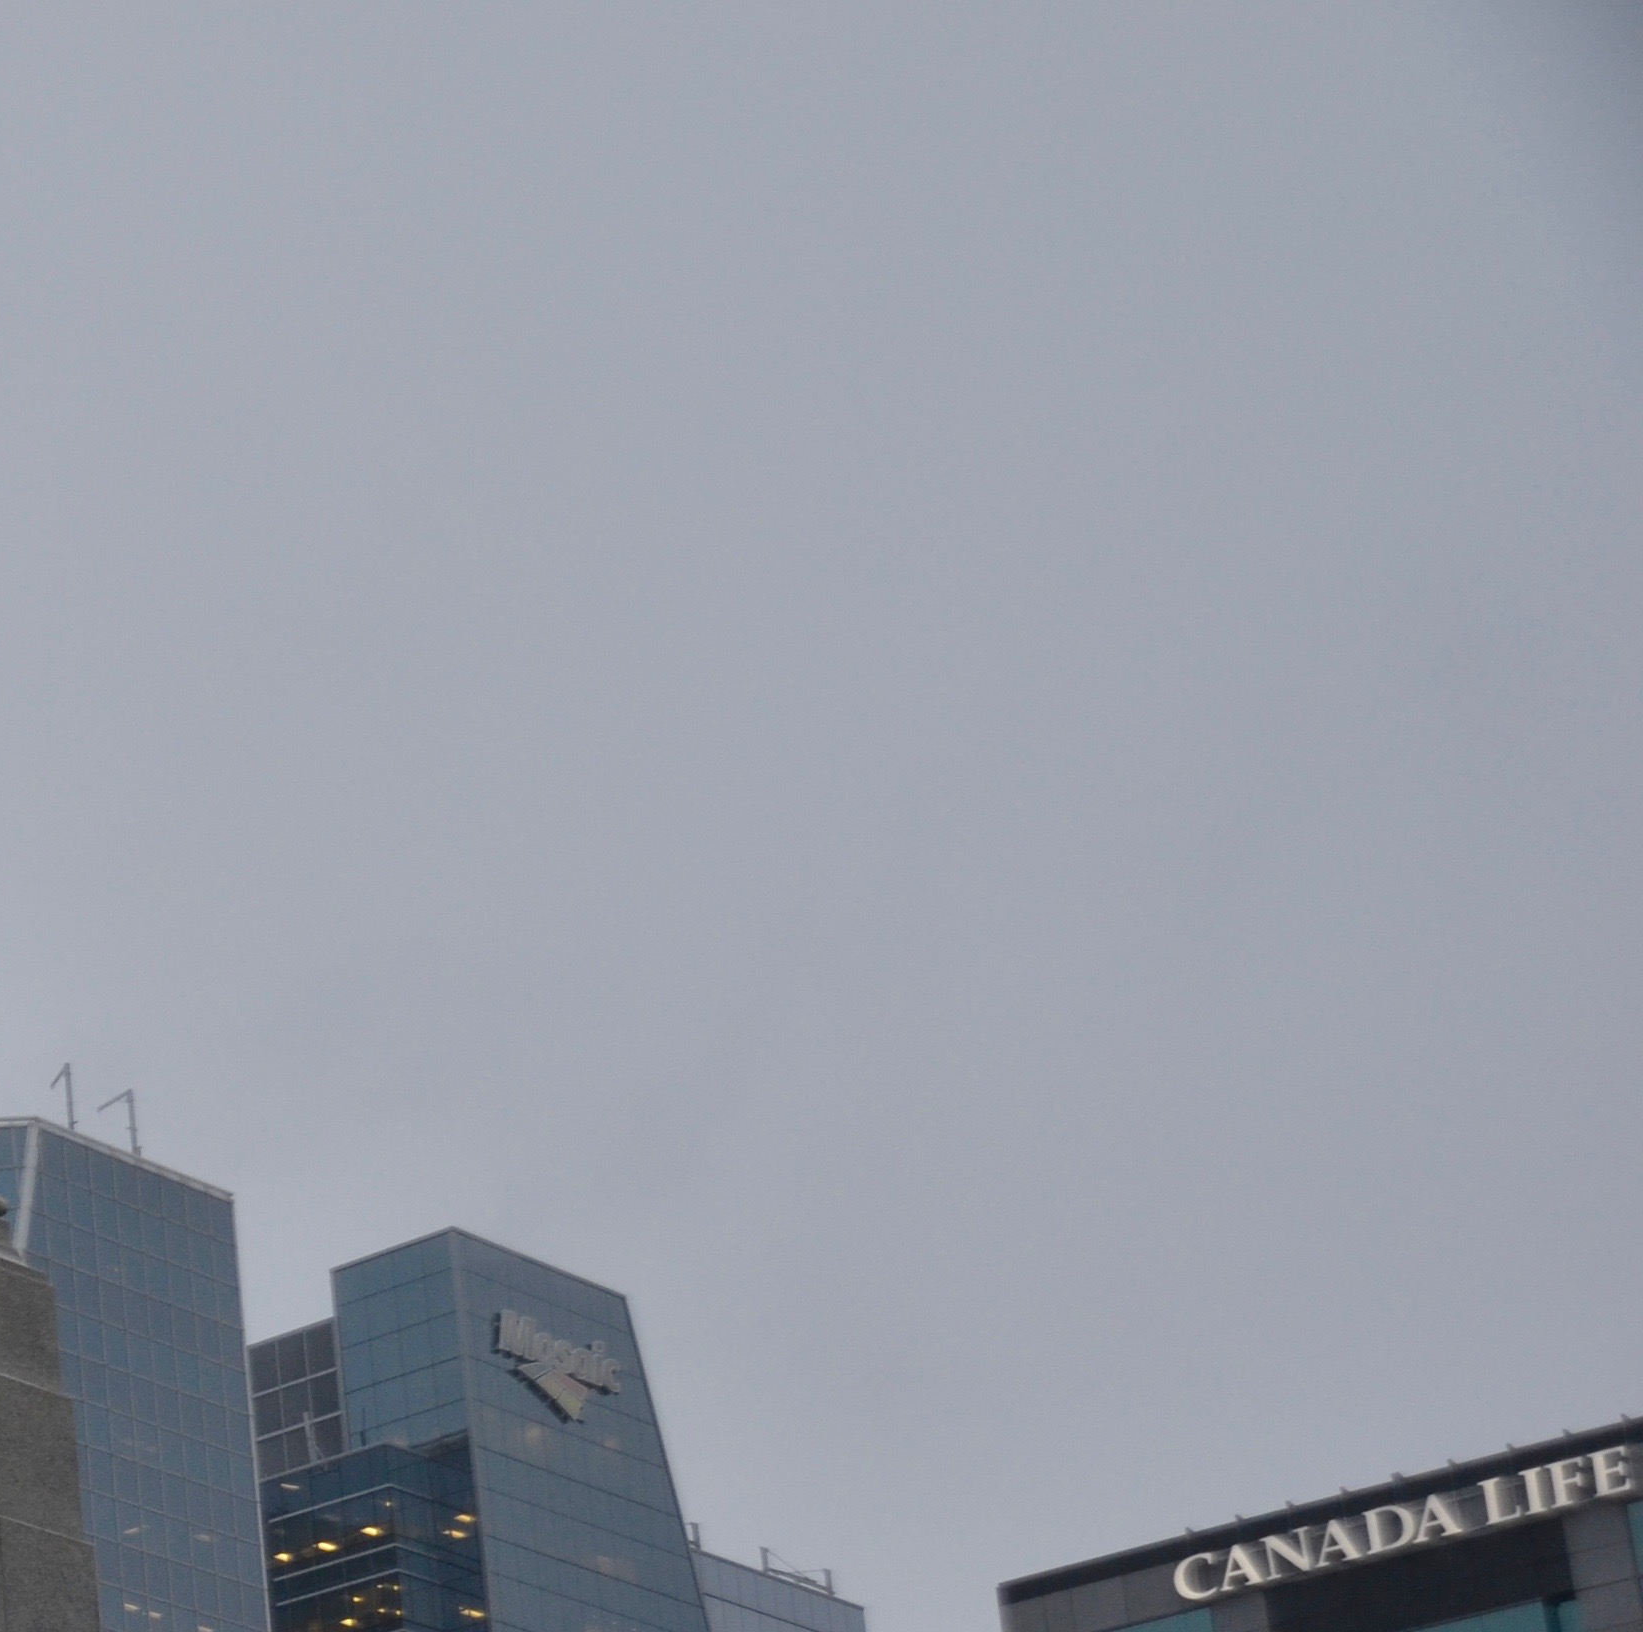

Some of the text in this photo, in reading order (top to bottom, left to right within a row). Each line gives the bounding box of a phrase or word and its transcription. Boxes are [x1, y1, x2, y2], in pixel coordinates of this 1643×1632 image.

[499, 1309, 620, 1393] Mosaic
[1173, 1444, 1636, 1602] CANADA LIFE
